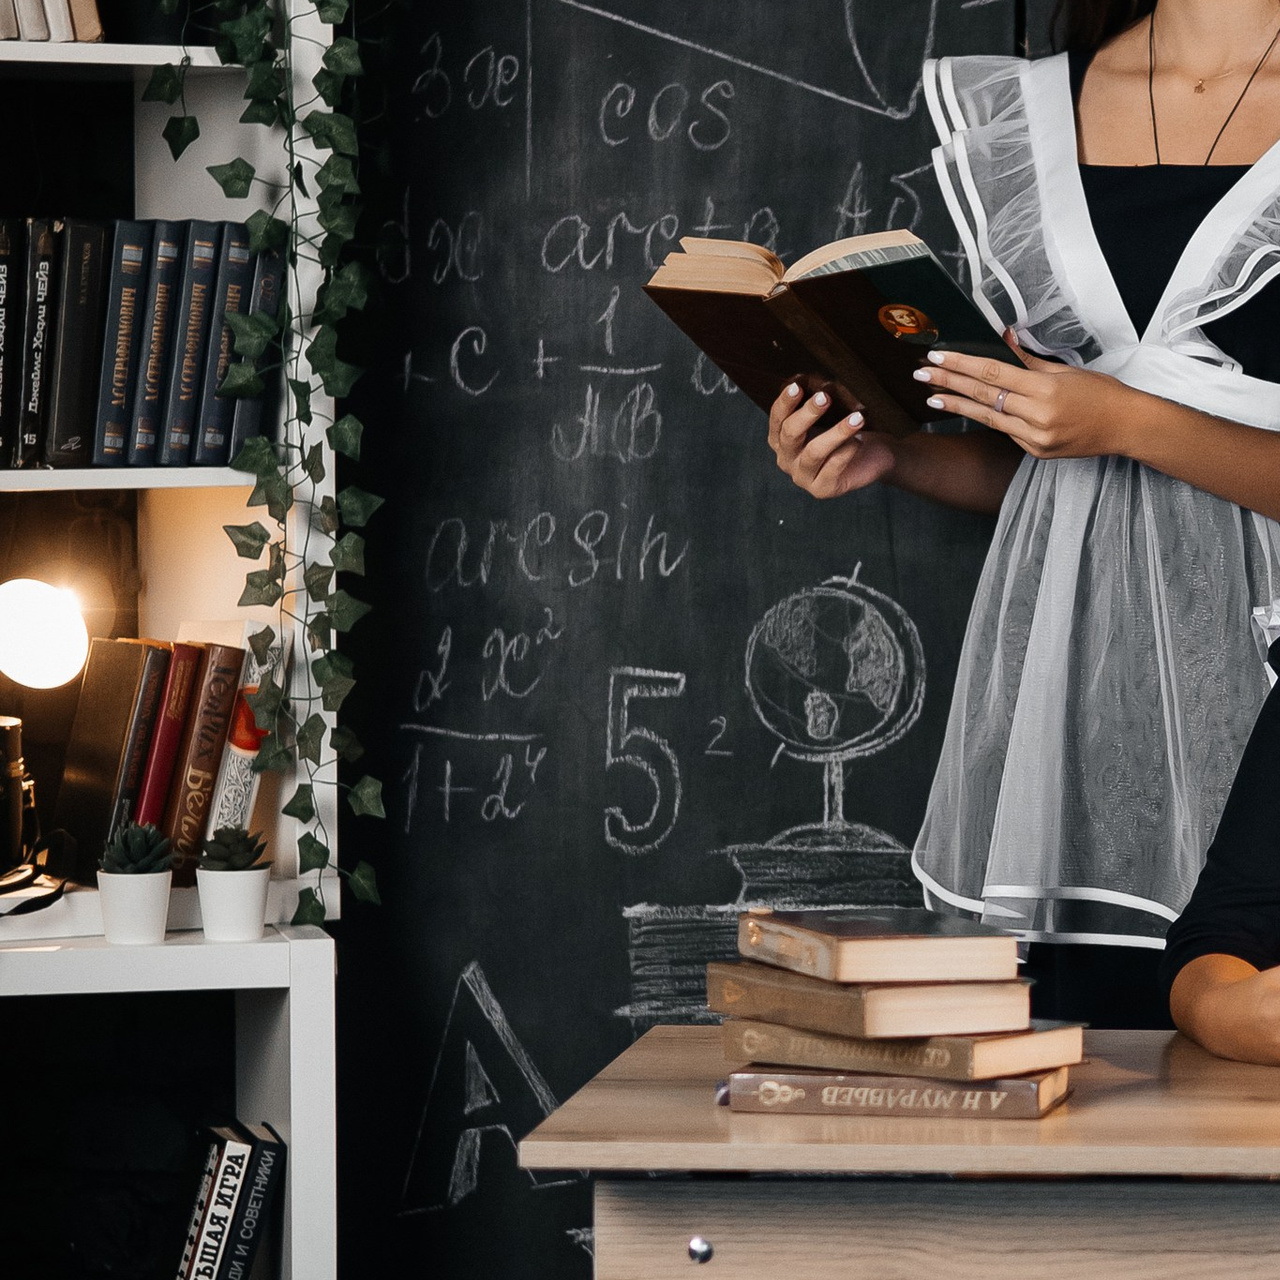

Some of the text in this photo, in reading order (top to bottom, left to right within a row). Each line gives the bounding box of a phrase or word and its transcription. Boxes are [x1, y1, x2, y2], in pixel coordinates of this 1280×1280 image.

[36, 261, 49, 302] ЧЕЙЗ
[28, 350, 45, 413] Джеймс
[23, 433, 36, 445] 15
[822, 1085, 958, 1107] МУРАВЬЕВ
[214, 1153, 246, 1210] ИГРА
[240, 1150, 276, 1240] СОВЕТНИКИ
[235, 1244, 249, 1257] И
